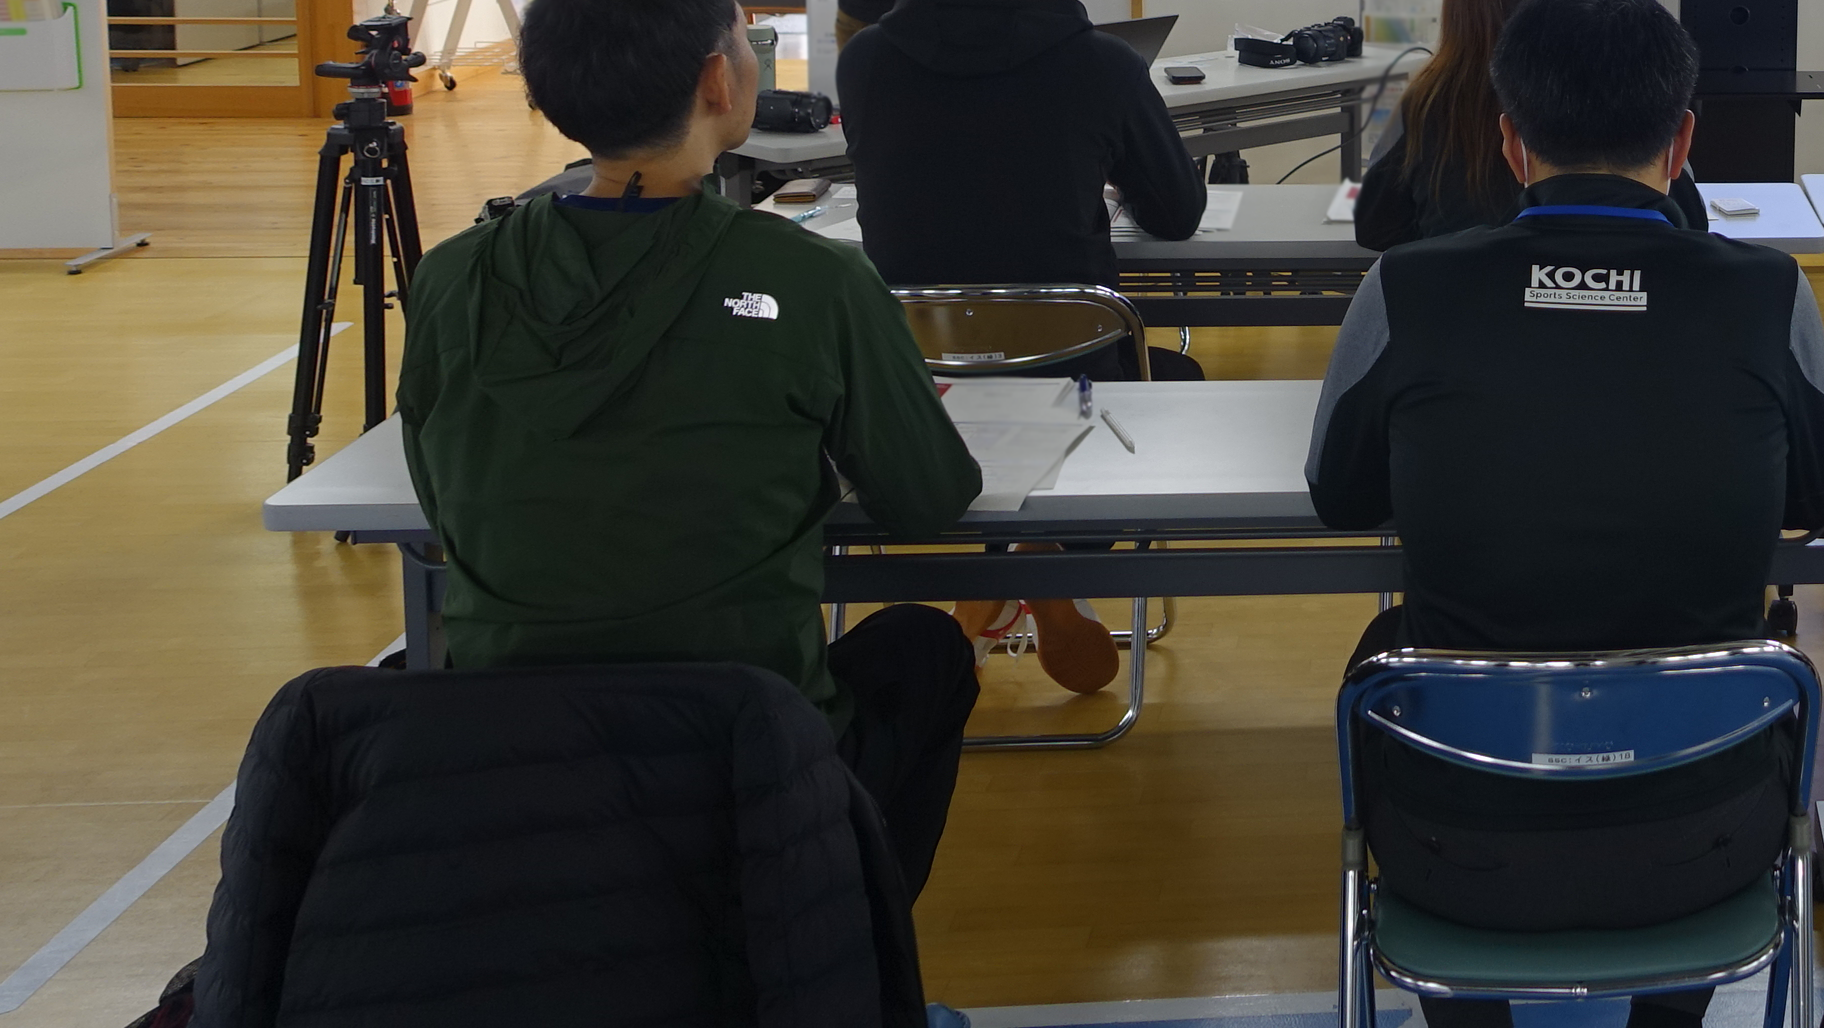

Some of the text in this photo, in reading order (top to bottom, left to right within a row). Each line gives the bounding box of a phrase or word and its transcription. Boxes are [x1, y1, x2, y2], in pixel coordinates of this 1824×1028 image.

[1531, 265, 1641, 291] KOCHI
[742, 292, 762, 301] THE
[1529, 290, 1643, 302] Sports Science Center
[724, 298, 760, 309] NORTH
[732, 308, 759, 317] FACE
